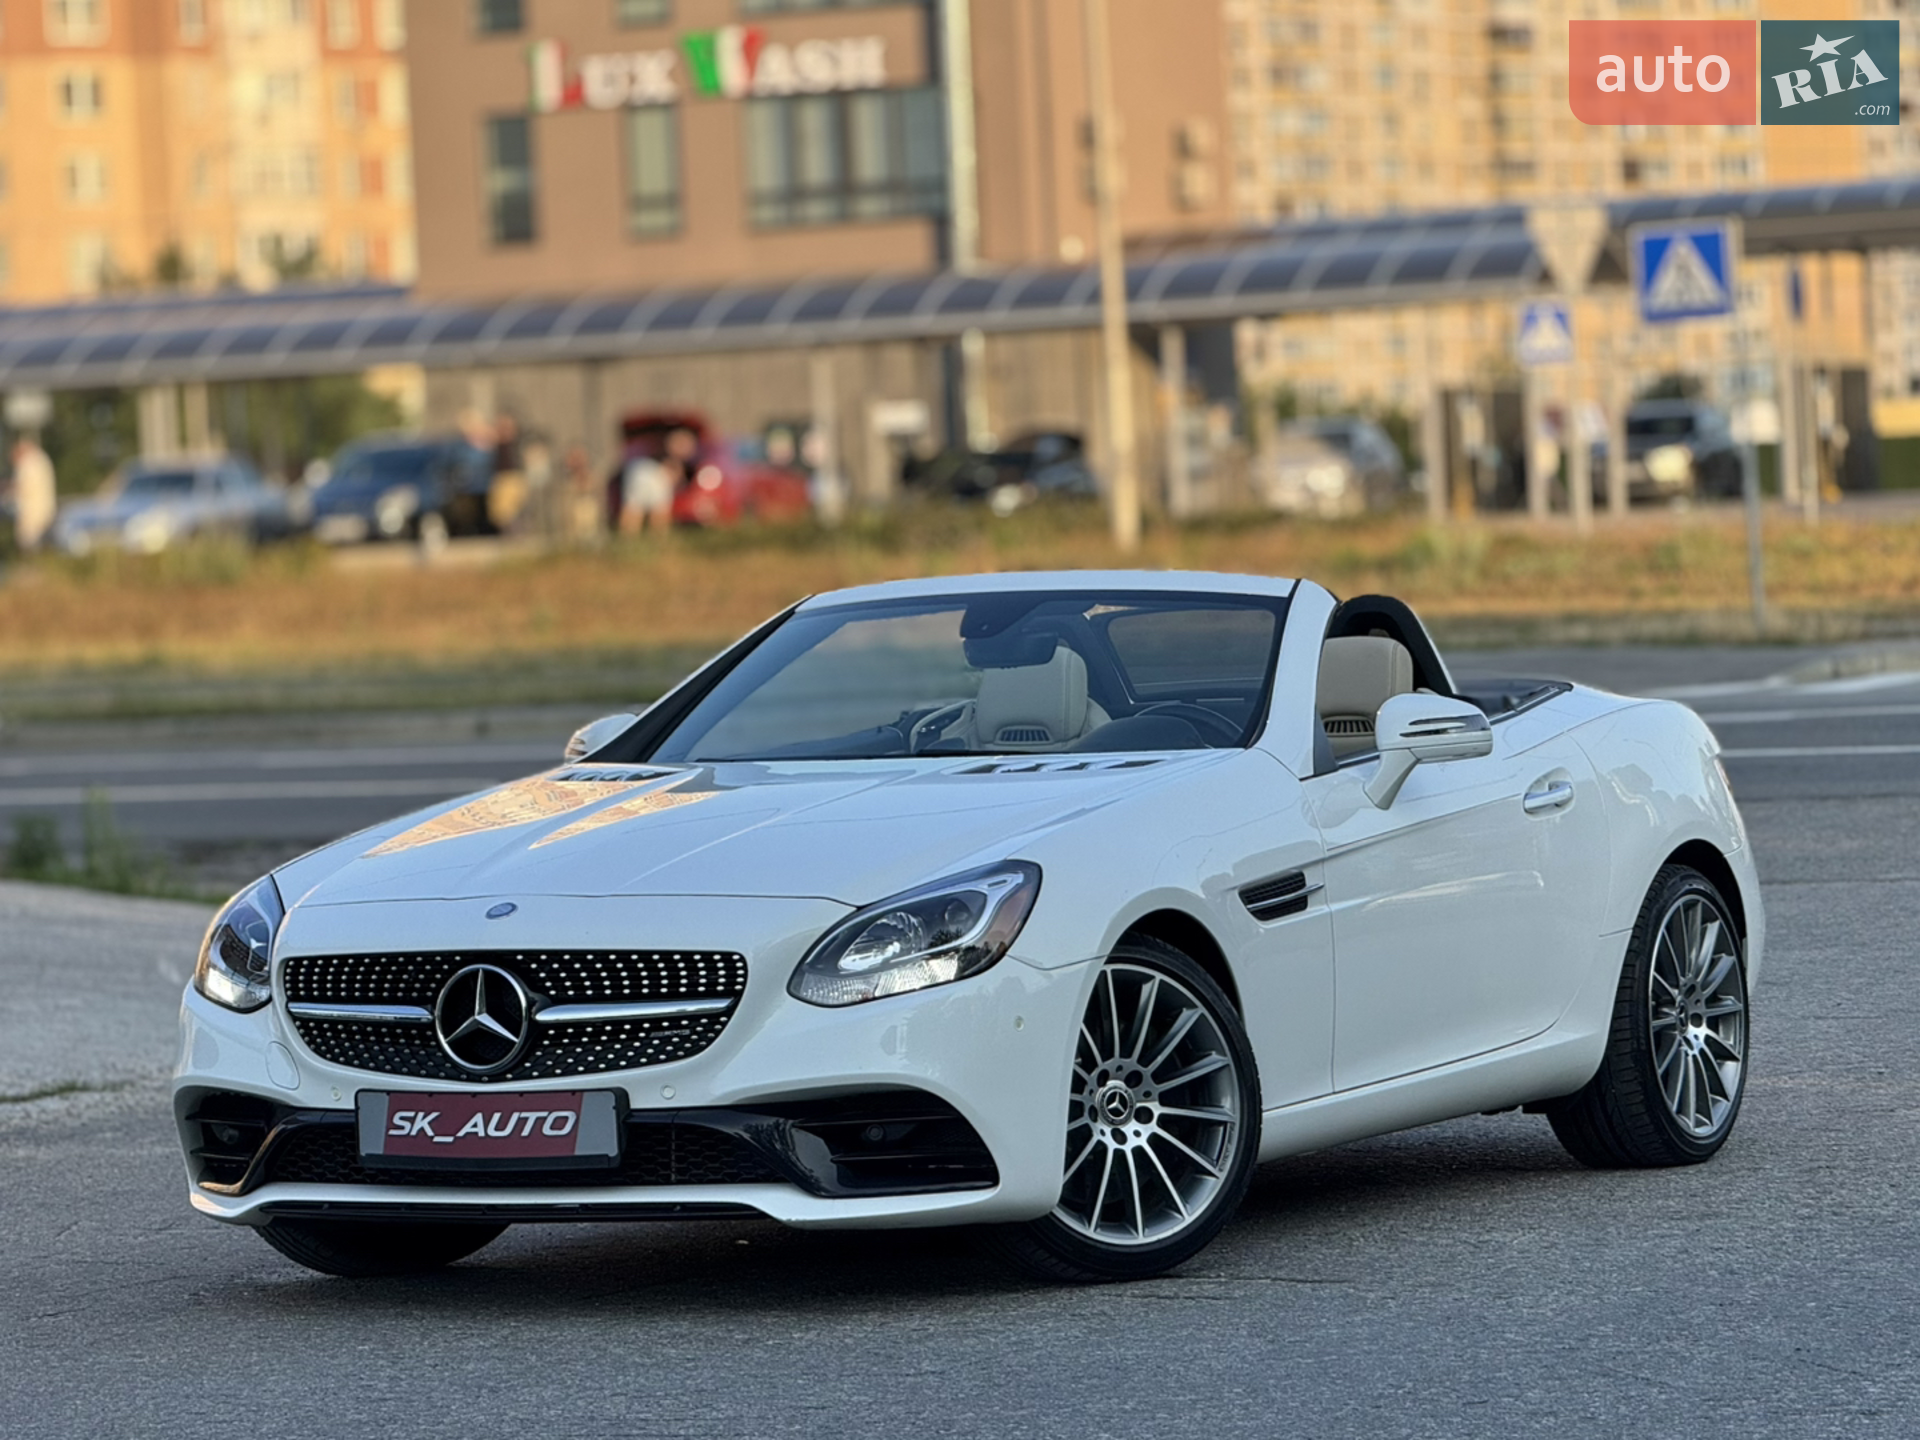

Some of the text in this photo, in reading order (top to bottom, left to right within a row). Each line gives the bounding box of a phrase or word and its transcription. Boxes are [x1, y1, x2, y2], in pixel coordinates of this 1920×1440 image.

[529, 25, 886, 112] LUX WASH
[388, 1110, 577, 1142] SK_AUTO
